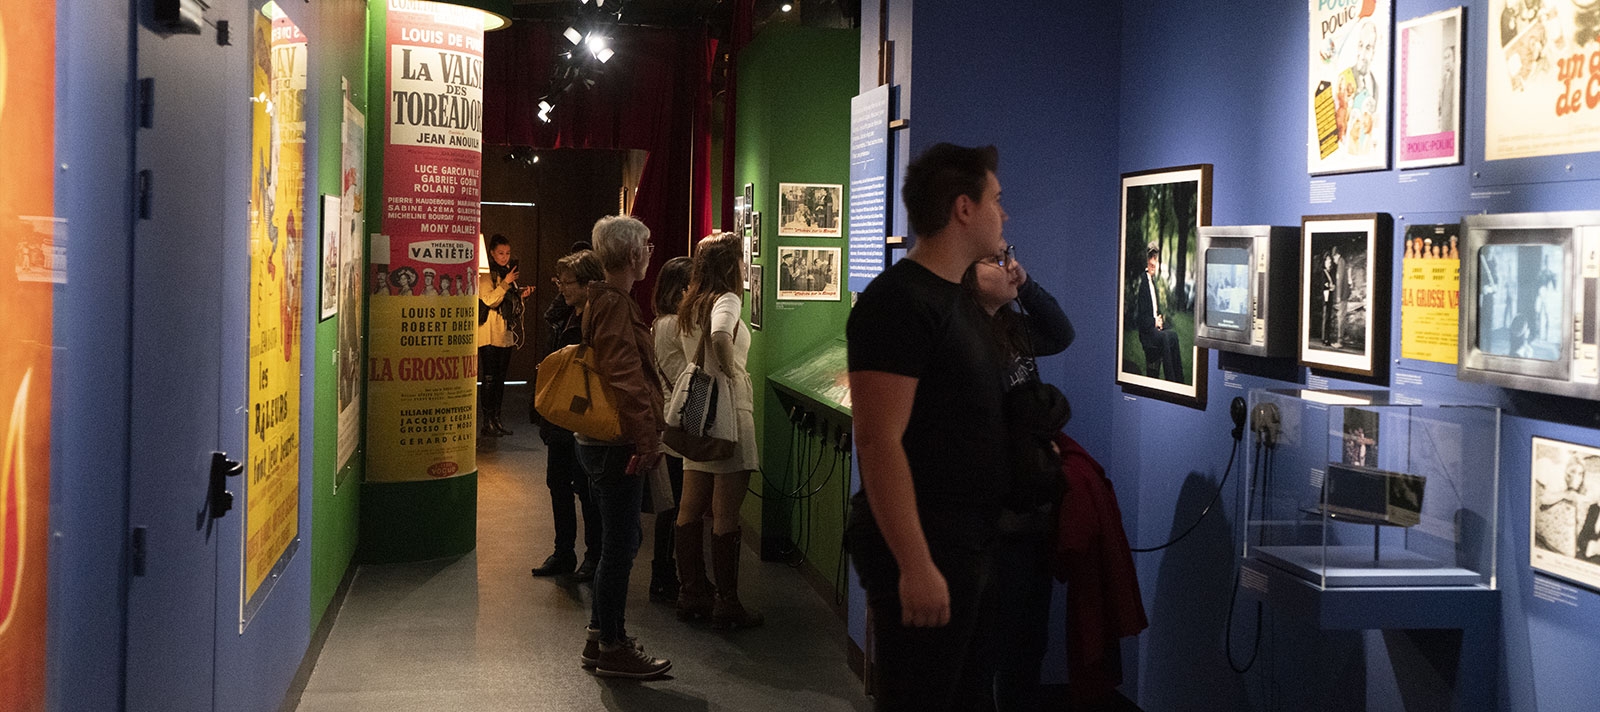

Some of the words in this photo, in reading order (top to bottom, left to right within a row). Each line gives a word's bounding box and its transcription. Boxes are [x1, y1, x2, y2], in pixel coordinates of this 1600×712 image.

[401, 27, 444, 45] LOUIS
[447, 33, 463, 48] DE
[1557, 53, 1585, 82] un
[446, 84, 467, 97] DES
[1555, 78, 1582, 117] de
[416, 132, 446, 146] JEAN
[414, 164, 438, 174] LUCE
[441, 166, 466, 176] GARCIA
[421, 174, 458, 185] GABRIEL
[414, 184, 455, 194] ROLAND
[421, 223, 449, 233] MONY
[1403, 288, 1414, 307] LA
[1416, 289, 1445, 309] GROSSE
[402, 308, 436, 319] LOUIS
[440, 308, 452, 318] DE
[401, 321, 447, 333] ROBERT
[400, 335, 443, 347] COLETTE
[447, 334, 474, 346] BROSSET
[368, 357, 394, 382] LA
[398, 356, 460, 382] GROSSE
[400, 408, 433, 417] LILIANE
[400, 416, 447, 427] JACQUES
[400, 425, 440, 434] GROSSO
[443, 423, 453, 432] ET
